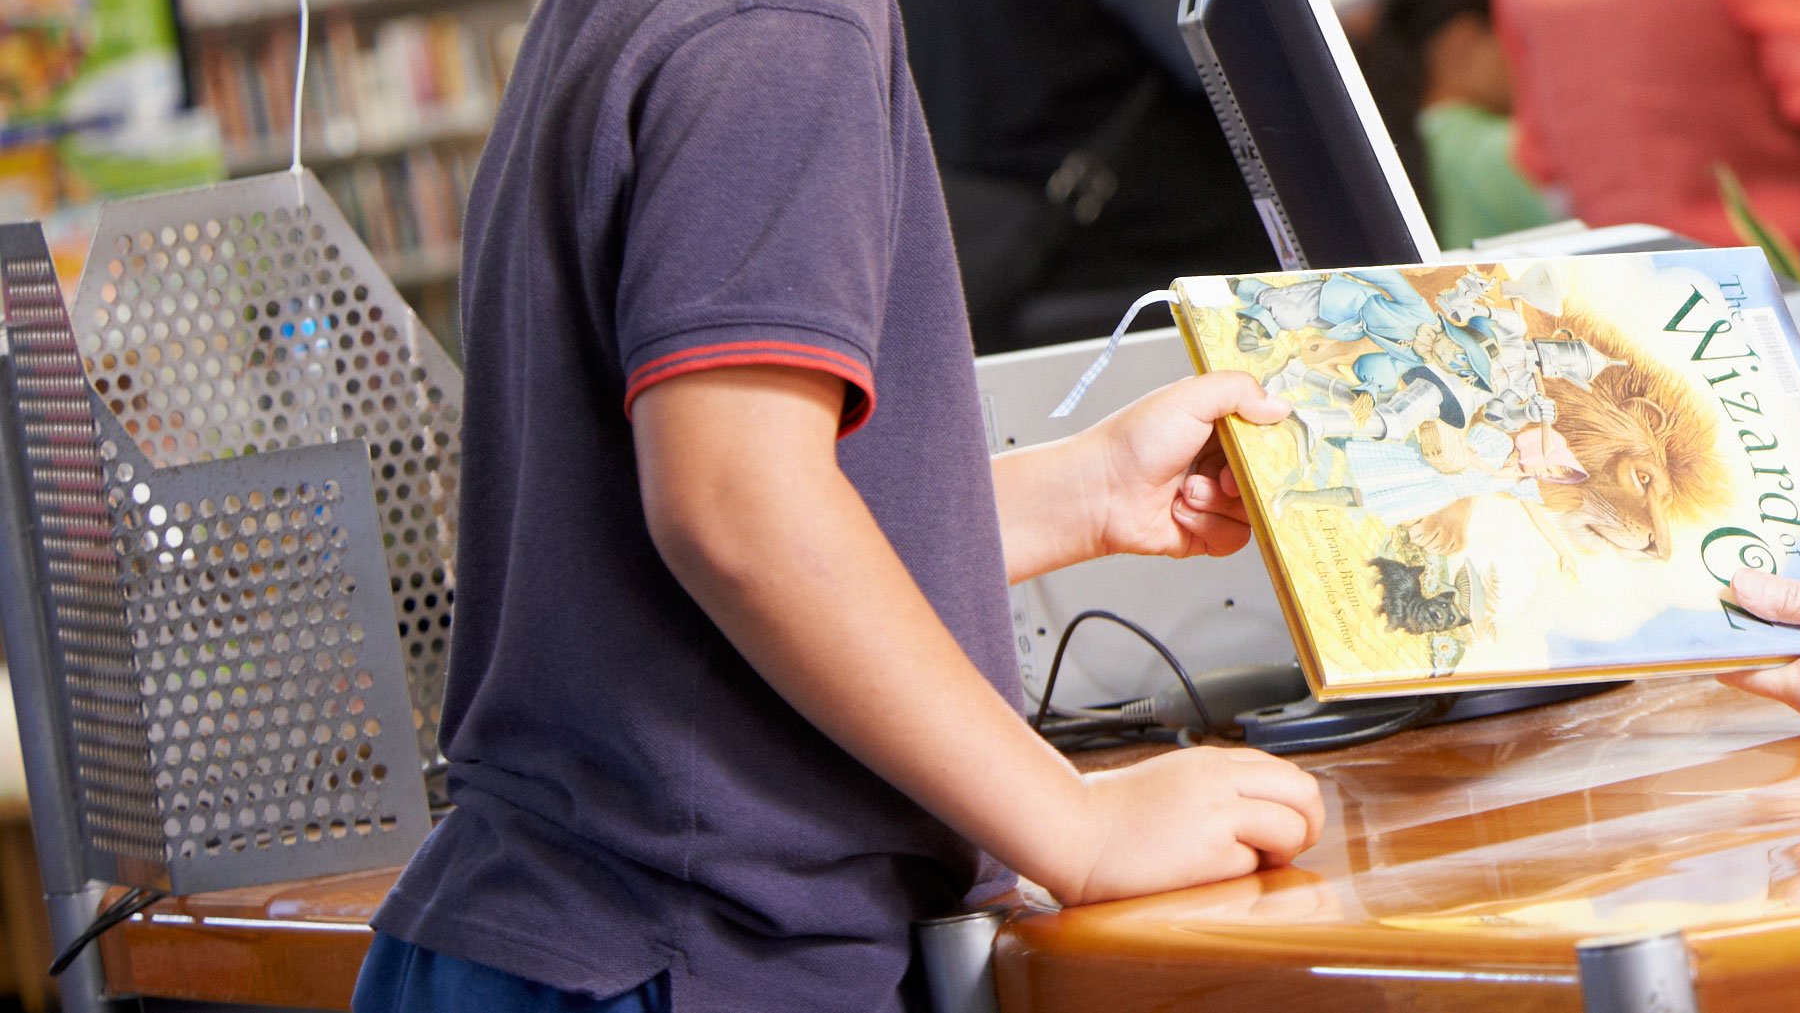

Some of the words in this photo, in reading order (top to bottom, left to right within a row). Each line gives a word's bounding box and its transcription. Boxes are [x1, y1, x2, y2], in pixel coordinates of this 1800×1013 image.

[1718, 274, 1748, 322] The
[1315, 561, 1337, 607] Charles
[1334, 607, 1357, 653] Santore
[1323, 527, 1348, 566] Frank
[1340, 570, 1360, 608] Baum
